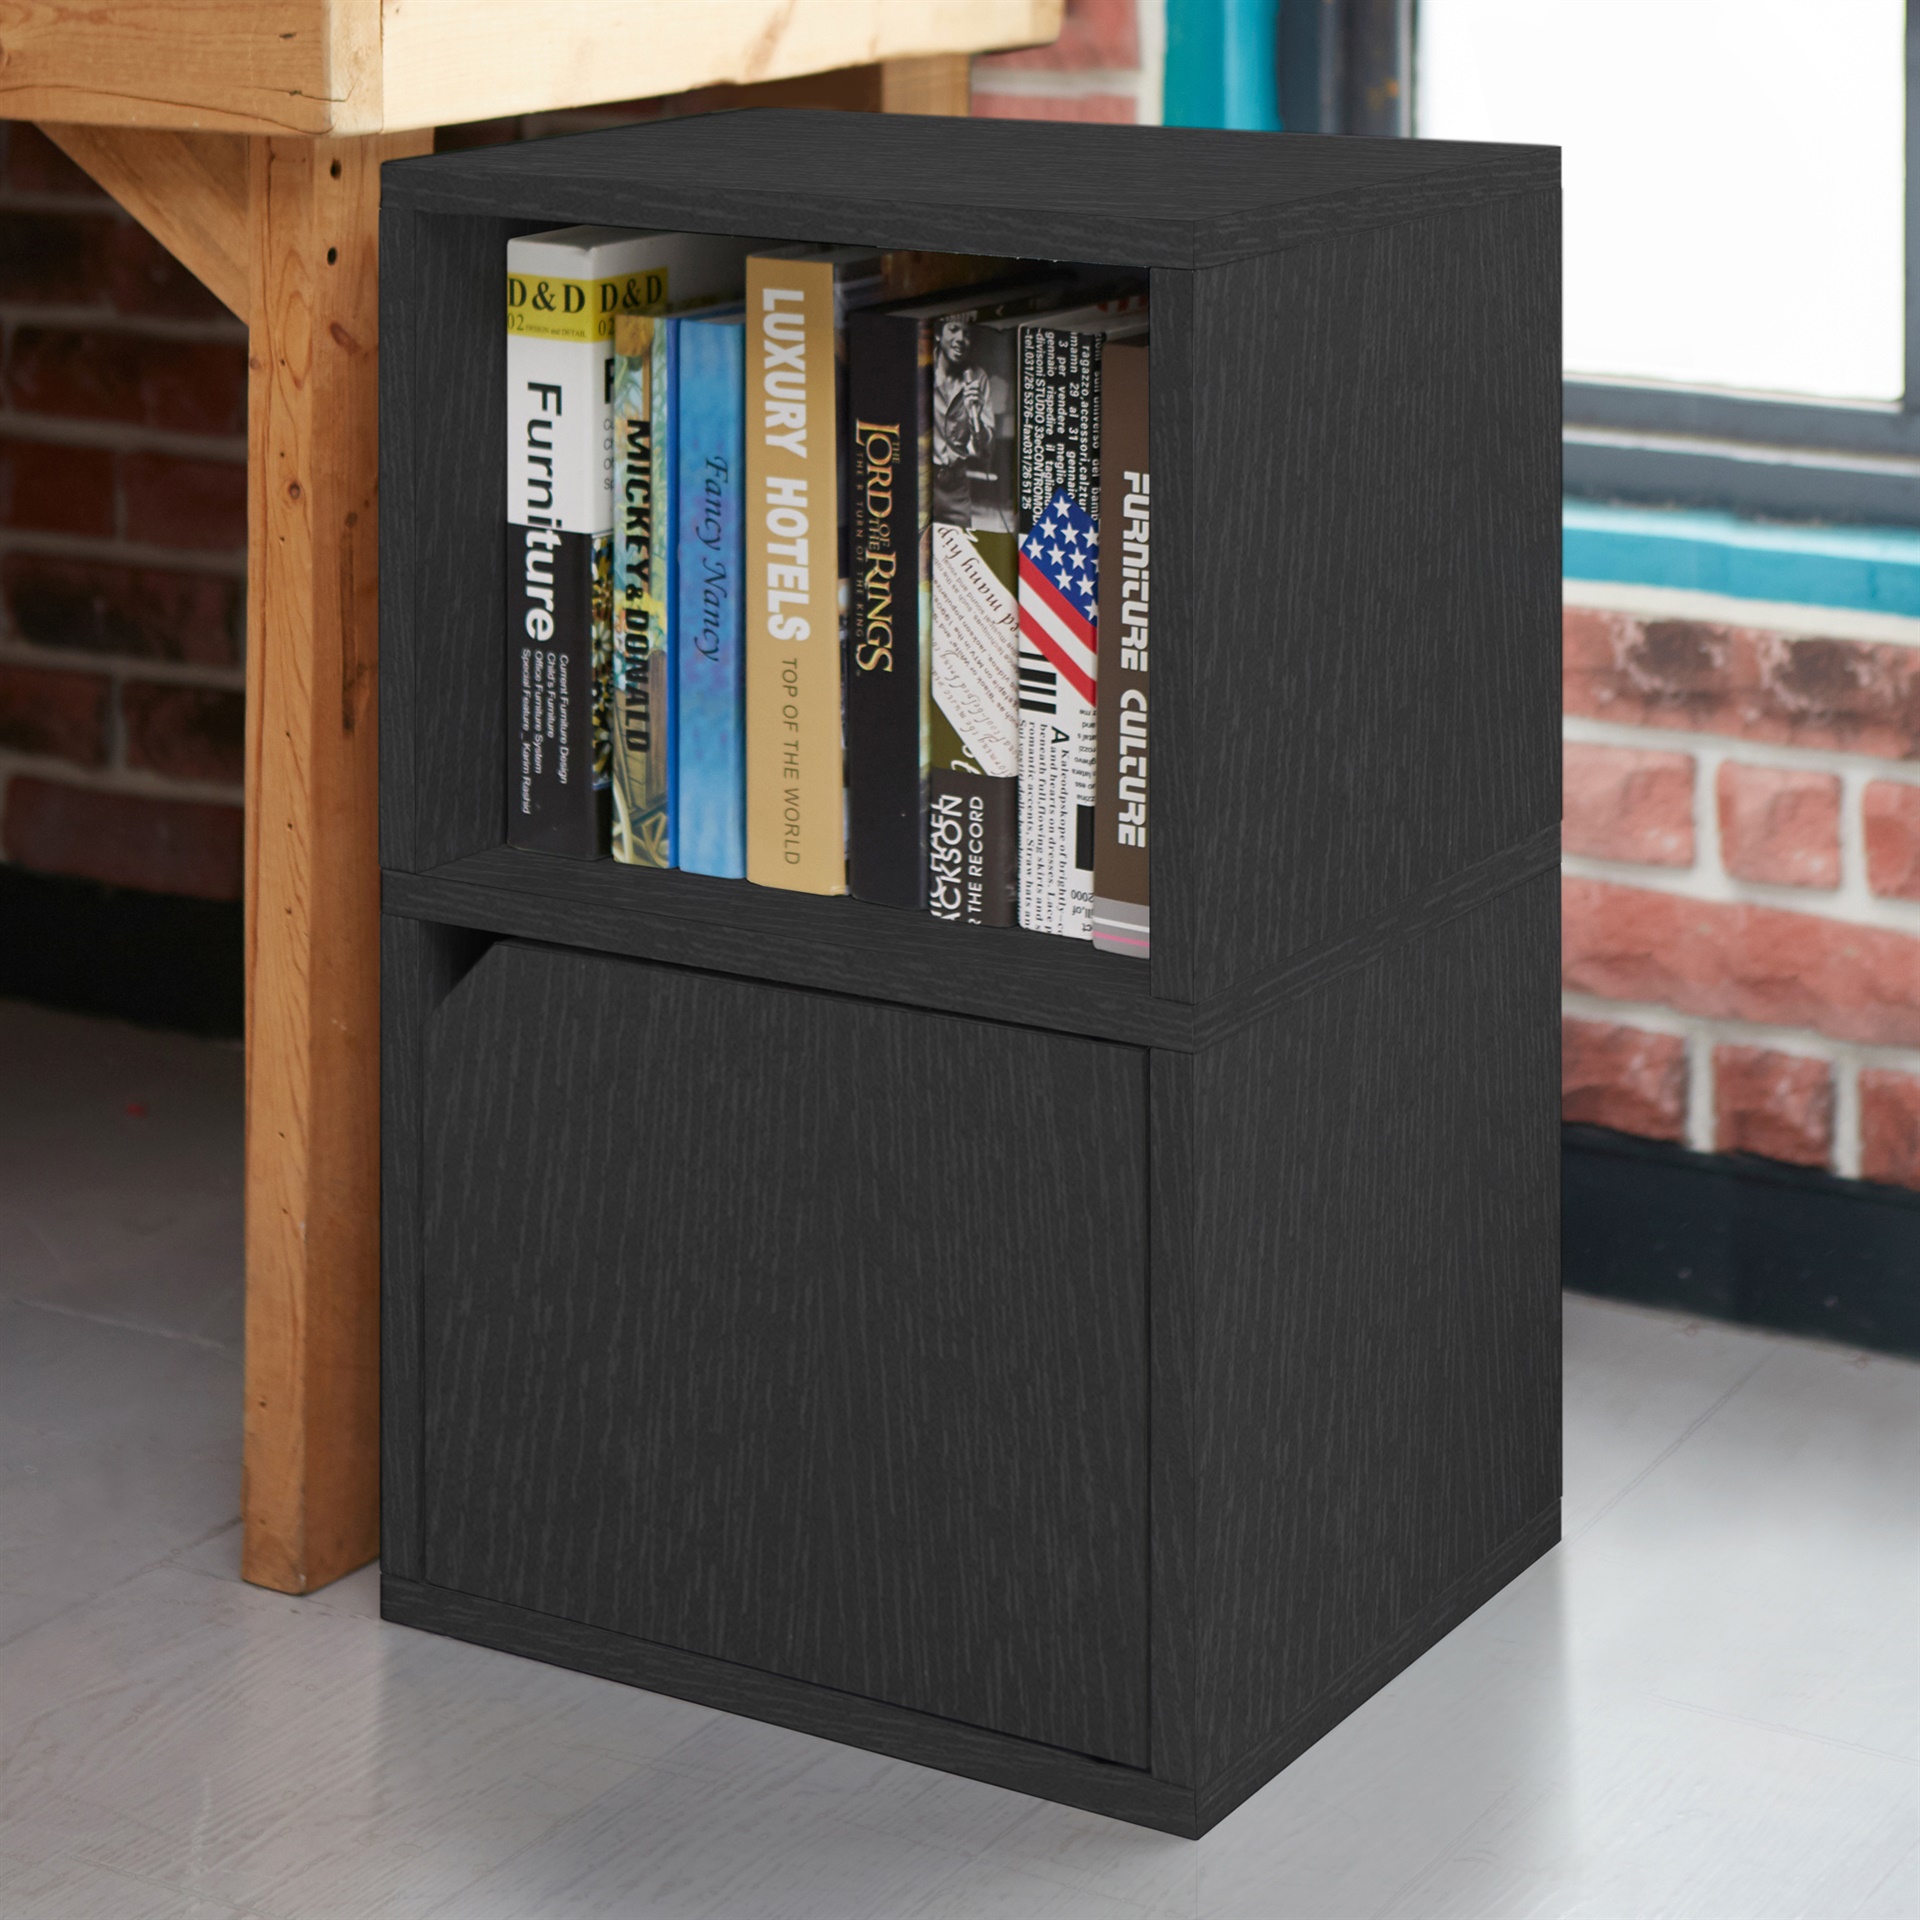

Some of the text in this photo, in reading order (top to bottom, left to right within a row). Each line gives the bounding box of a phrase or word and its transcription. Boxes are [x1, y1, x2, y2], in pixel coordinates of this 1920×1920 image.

[508, 313, 524, 331] 02
[525, 324, 549, 333] DESIGN
[562, 328, 586, 337] DETAIL
[1045, 332, 1056, 377] gennaio
[1035, 378, 1045, 424] STUDIO
[1069, 382, 1079, 397] 29
[1045, 385, 1055, 435] rispedire
[1055, 340, 1068, 484] 3 per vendere meglio
[1069, 407, 1079, 418] al
[1069, 427, 1078, 441] 31
[762, 288, 811, 641] LUXURY HOTELS
[856, 452, 864, 476] THE
[892, 442, 900, 463] THE
[1021, 496, 1031, 510] 25
[1022, 481, 1031, 493] 51
[525, 381, 562, 641] Furniture
[694, 455, 729, 662] Fancy Nancy
[855, 418, 900, 672] LORD OF THE RINGS
[856, 546, 864, 562] OF
[937, 528, 962, 560] hip
[624, 419, 650, 753] MICKEY & DONALD
[856, 571, 864, 595] THE
[954, 577, 968, 592] and
[960, 558, 1002, 611] many
[856, 604, 864, 637] KING
[937, 622, 951, 638] and
[951, 627, 964, 641] the
[960, 620, 986, 653] Jackson
[522, 649, 531, 687] Special
[969, 649, 984, 668] MTV
[523, 690, 531, 731] Feature
[533, 651, 543, 773] Office Furniture System
[547, 653, 556, 738] Child's Furniture
[558, 654, 568, 784] Current Furniture Design
[1051, 726, 1070, 744] A
[523, 743, 531, 773] Karim
[782, 657, 800, 865] TOP OF THE WORLD
[1028, 721, 1036, 781] romantic
[1039, 724, 1048, 774] beneath
[1050, 747, 1058, 770] and
[523, 777, 531, 814] Rashid
[1026, 783, 1034, 835] accents,
[1049, 774, 1058, 815] hearts
[968, 796, 984, 877] RECORD
[1049, 818, 1055, 833] on
[1026, 838, 1034, 877] Straw
[1047, 837, 1055, 887] dresses.
[1059, 845, 1067, 857] of
[1037, 857, 1045, 894] skirts
[968, 882, 982, 913] THE
[1025, 880, 1034, 907] hats
[1036, 897, 1044, 921] and
[1047, 892, 1055, 922] Lace
[1071, 890, 1094, 903] 2000
